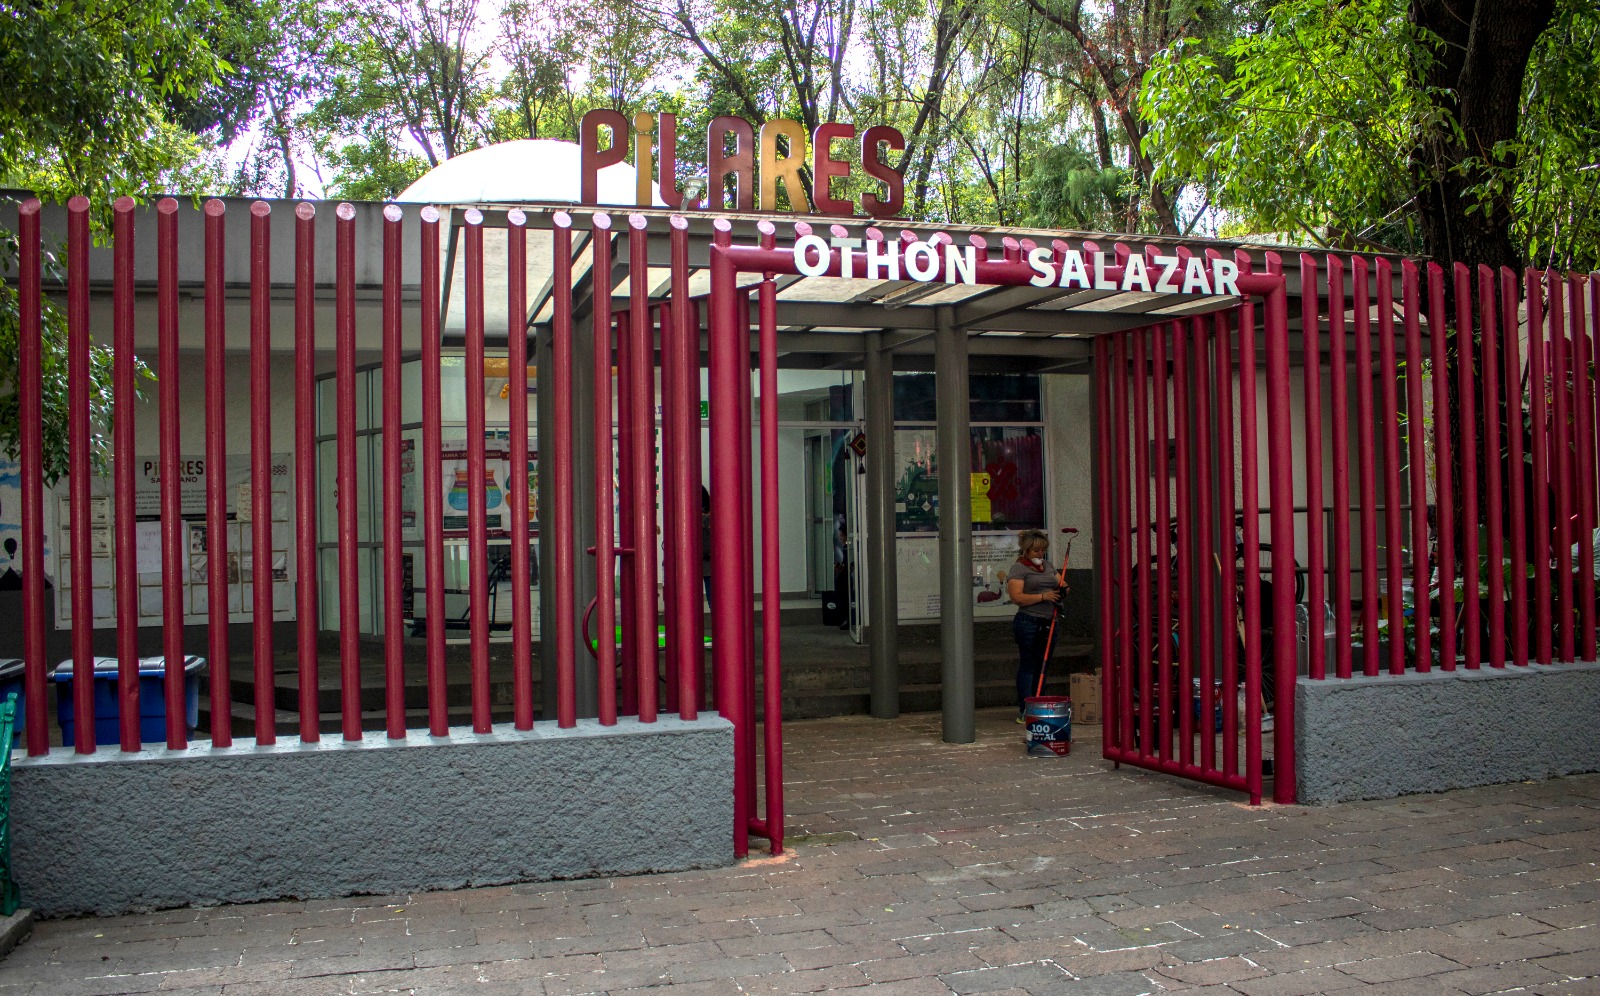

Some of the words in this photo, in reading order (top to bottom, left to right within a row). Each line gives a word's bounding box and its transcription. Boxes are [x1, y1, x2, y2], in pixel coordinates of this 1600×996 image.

[794, 232, 976, 285] OTHÓN
[1029, 247, 1241, 296] SALAZAR
[1031, 724, 1050, 733] 100
[1029, 732, 1056, 741] OTAL
